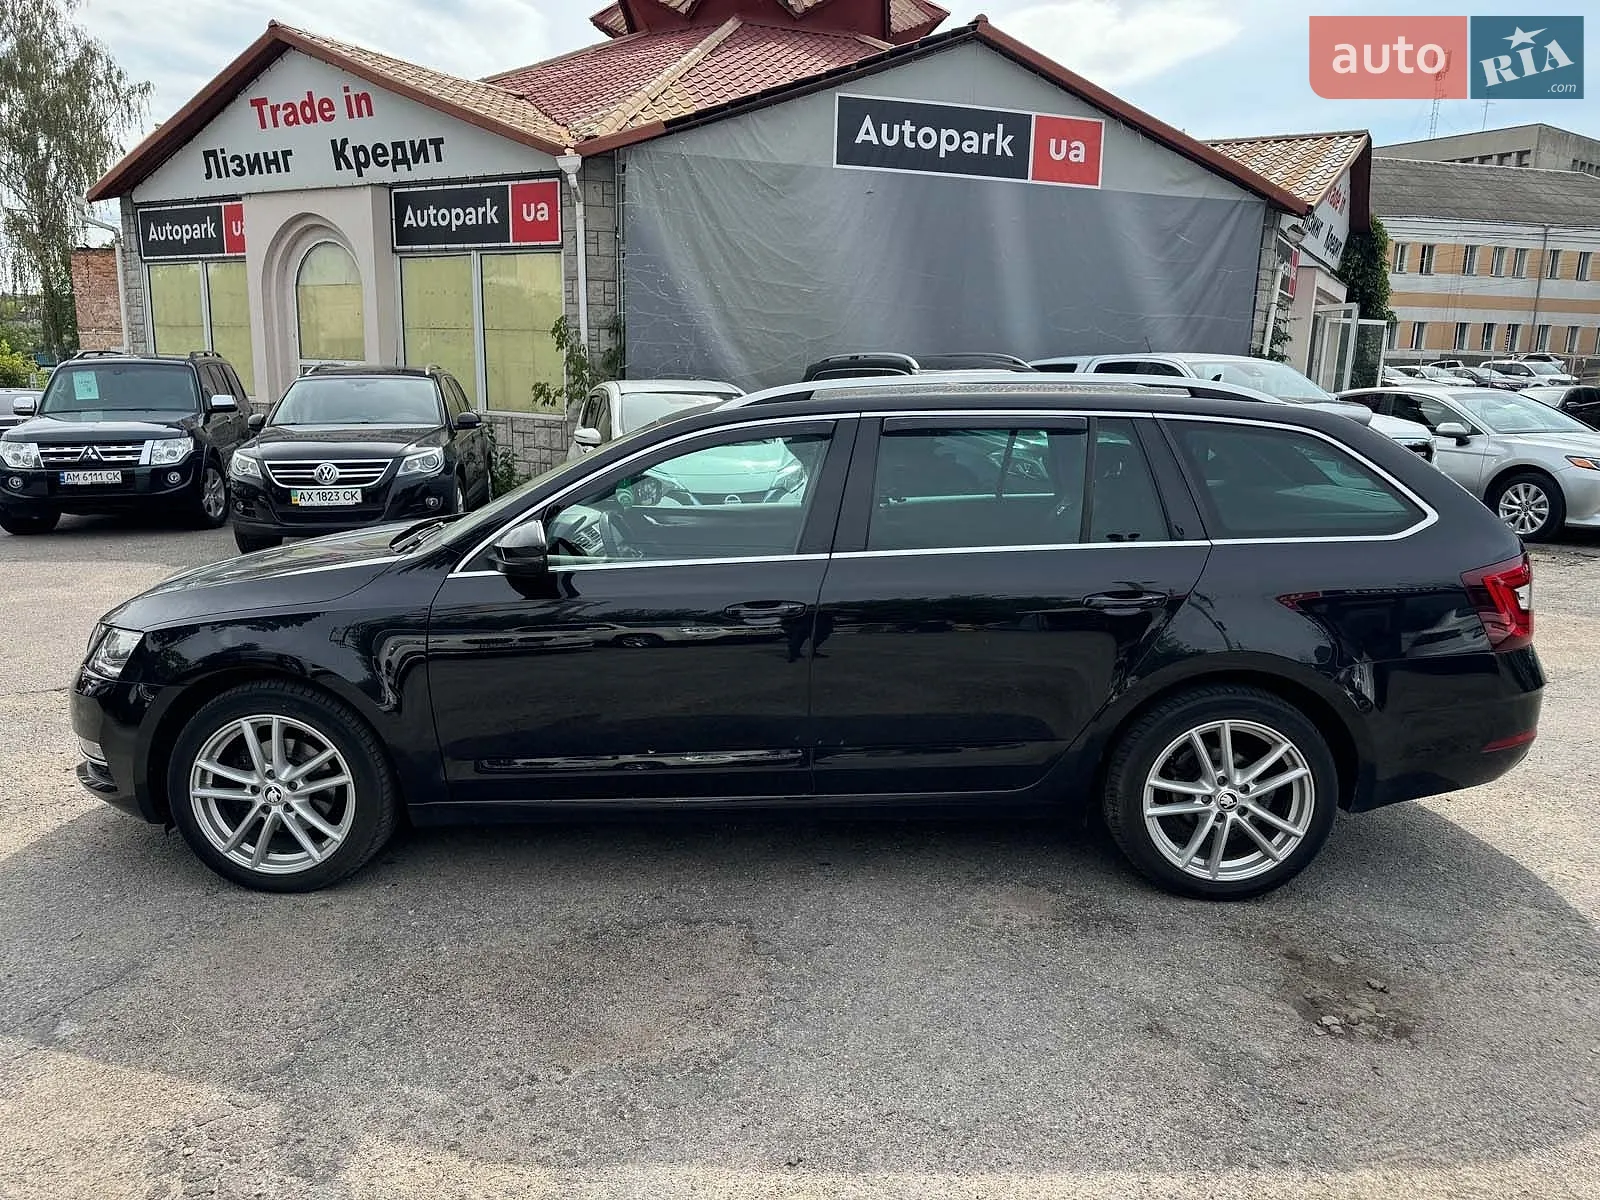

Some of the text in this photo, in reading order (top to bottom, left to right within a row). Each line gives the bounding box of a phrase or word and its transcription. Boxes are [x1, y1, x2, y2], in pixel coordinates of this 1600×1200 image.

[250, 86, 374, 129] Trade in
[854, 114, 1086, 163] Autopark ua
[202, 137, 444, 180] Лізинг Кредит
[148, 216, 216, 244] Autopark
[403, 198, 549, 231] Autopark ua
[82, 472, 104, 481] 6111
[106, 472, 120, 481] CK
[299, 490, 359, 502] AX 1823 CK
